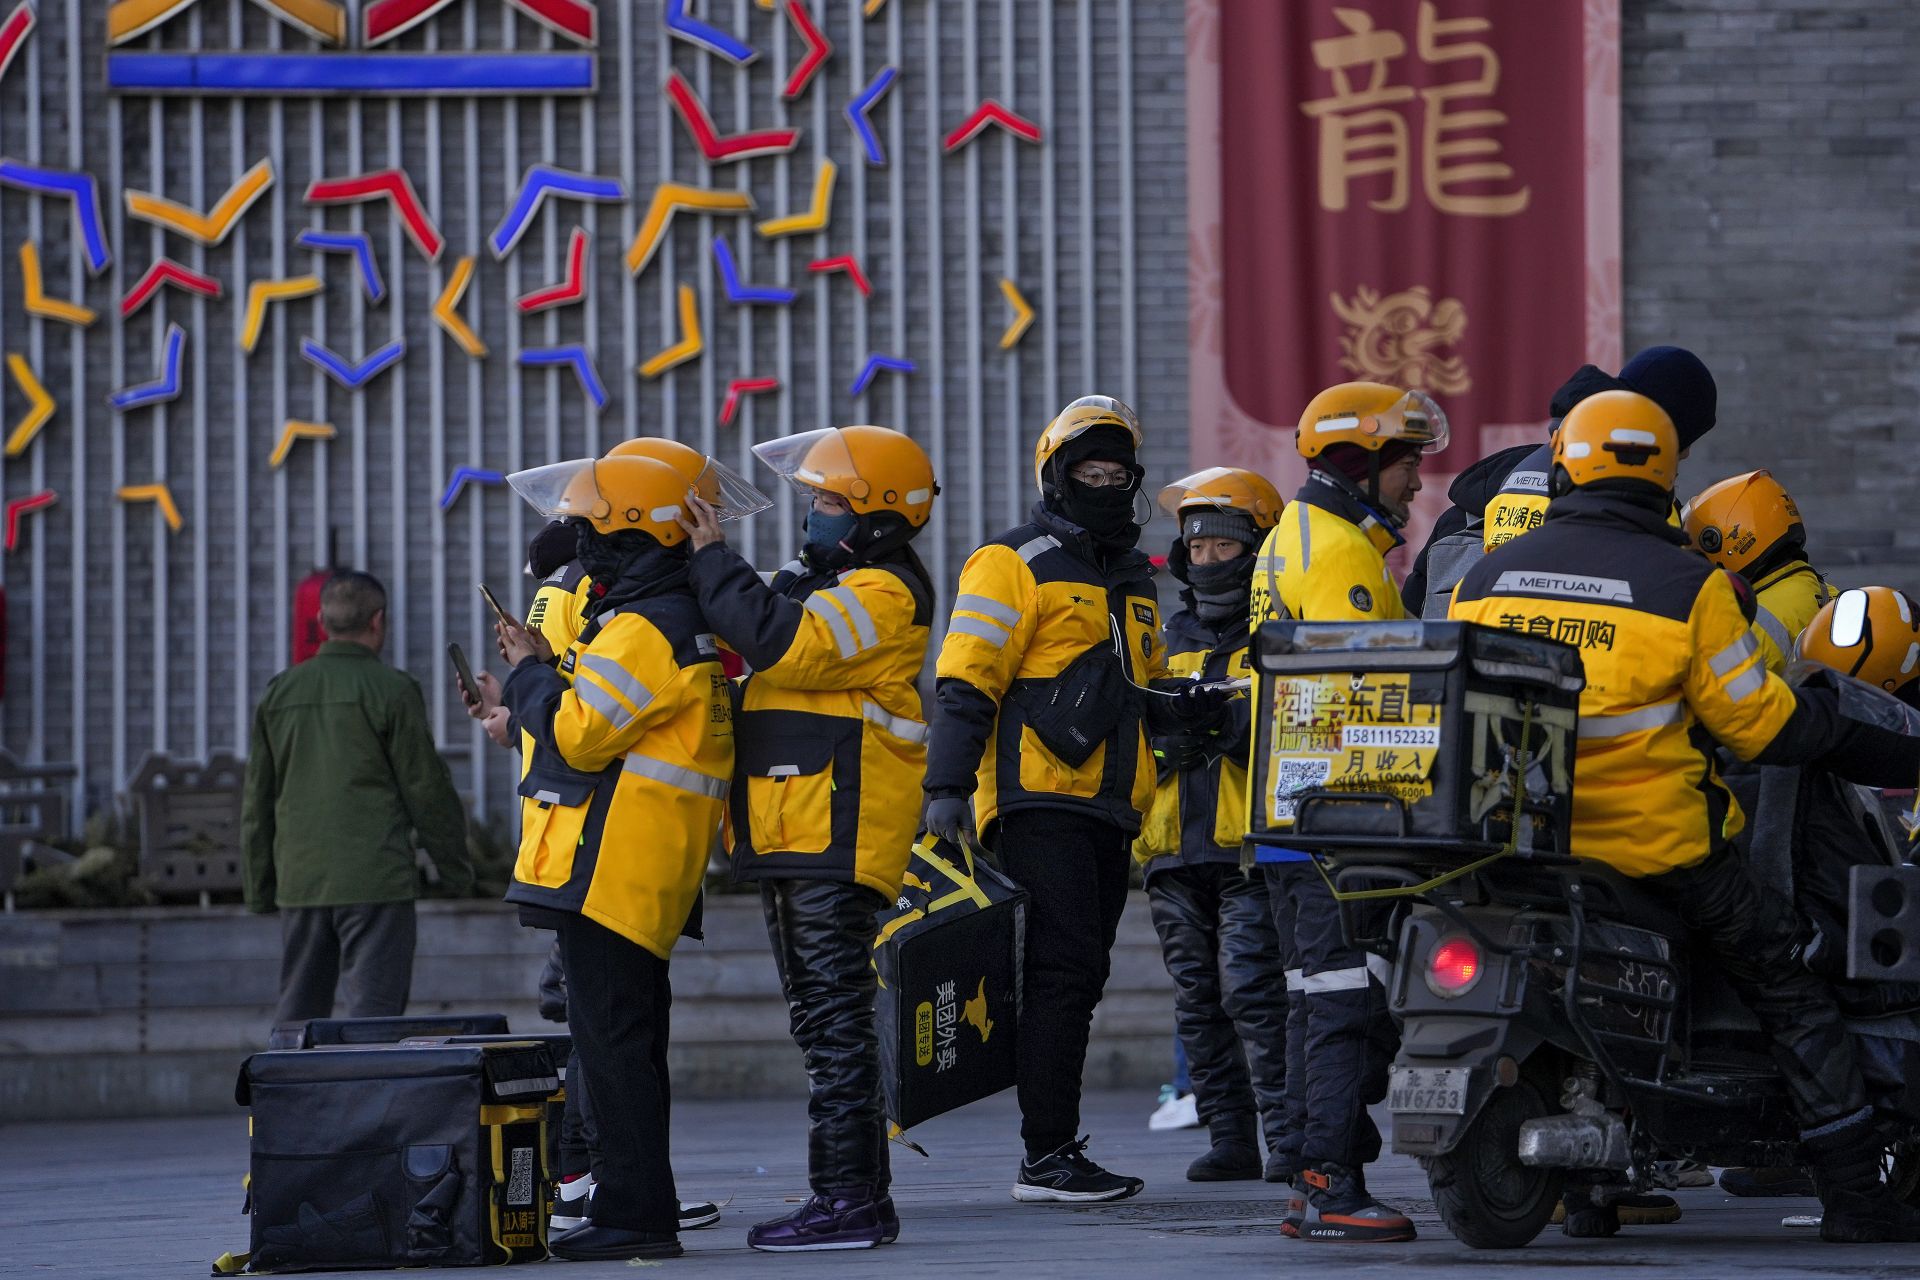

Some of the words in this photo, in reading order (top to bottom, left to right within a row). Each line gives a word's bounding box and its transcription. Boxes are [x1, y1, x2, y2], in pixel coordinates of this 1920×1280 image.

[1300, 0, 1531, 217] 龍
[1519, 576, 1603, 594] MEITUAN
[1498, 613, 1617, 652] 美食团购
[1346, 729, 1435, 744] 15811152232
[1345, 751, 1422, 774] 月收入
[936, 979, 957, 1073] 美团外卖
